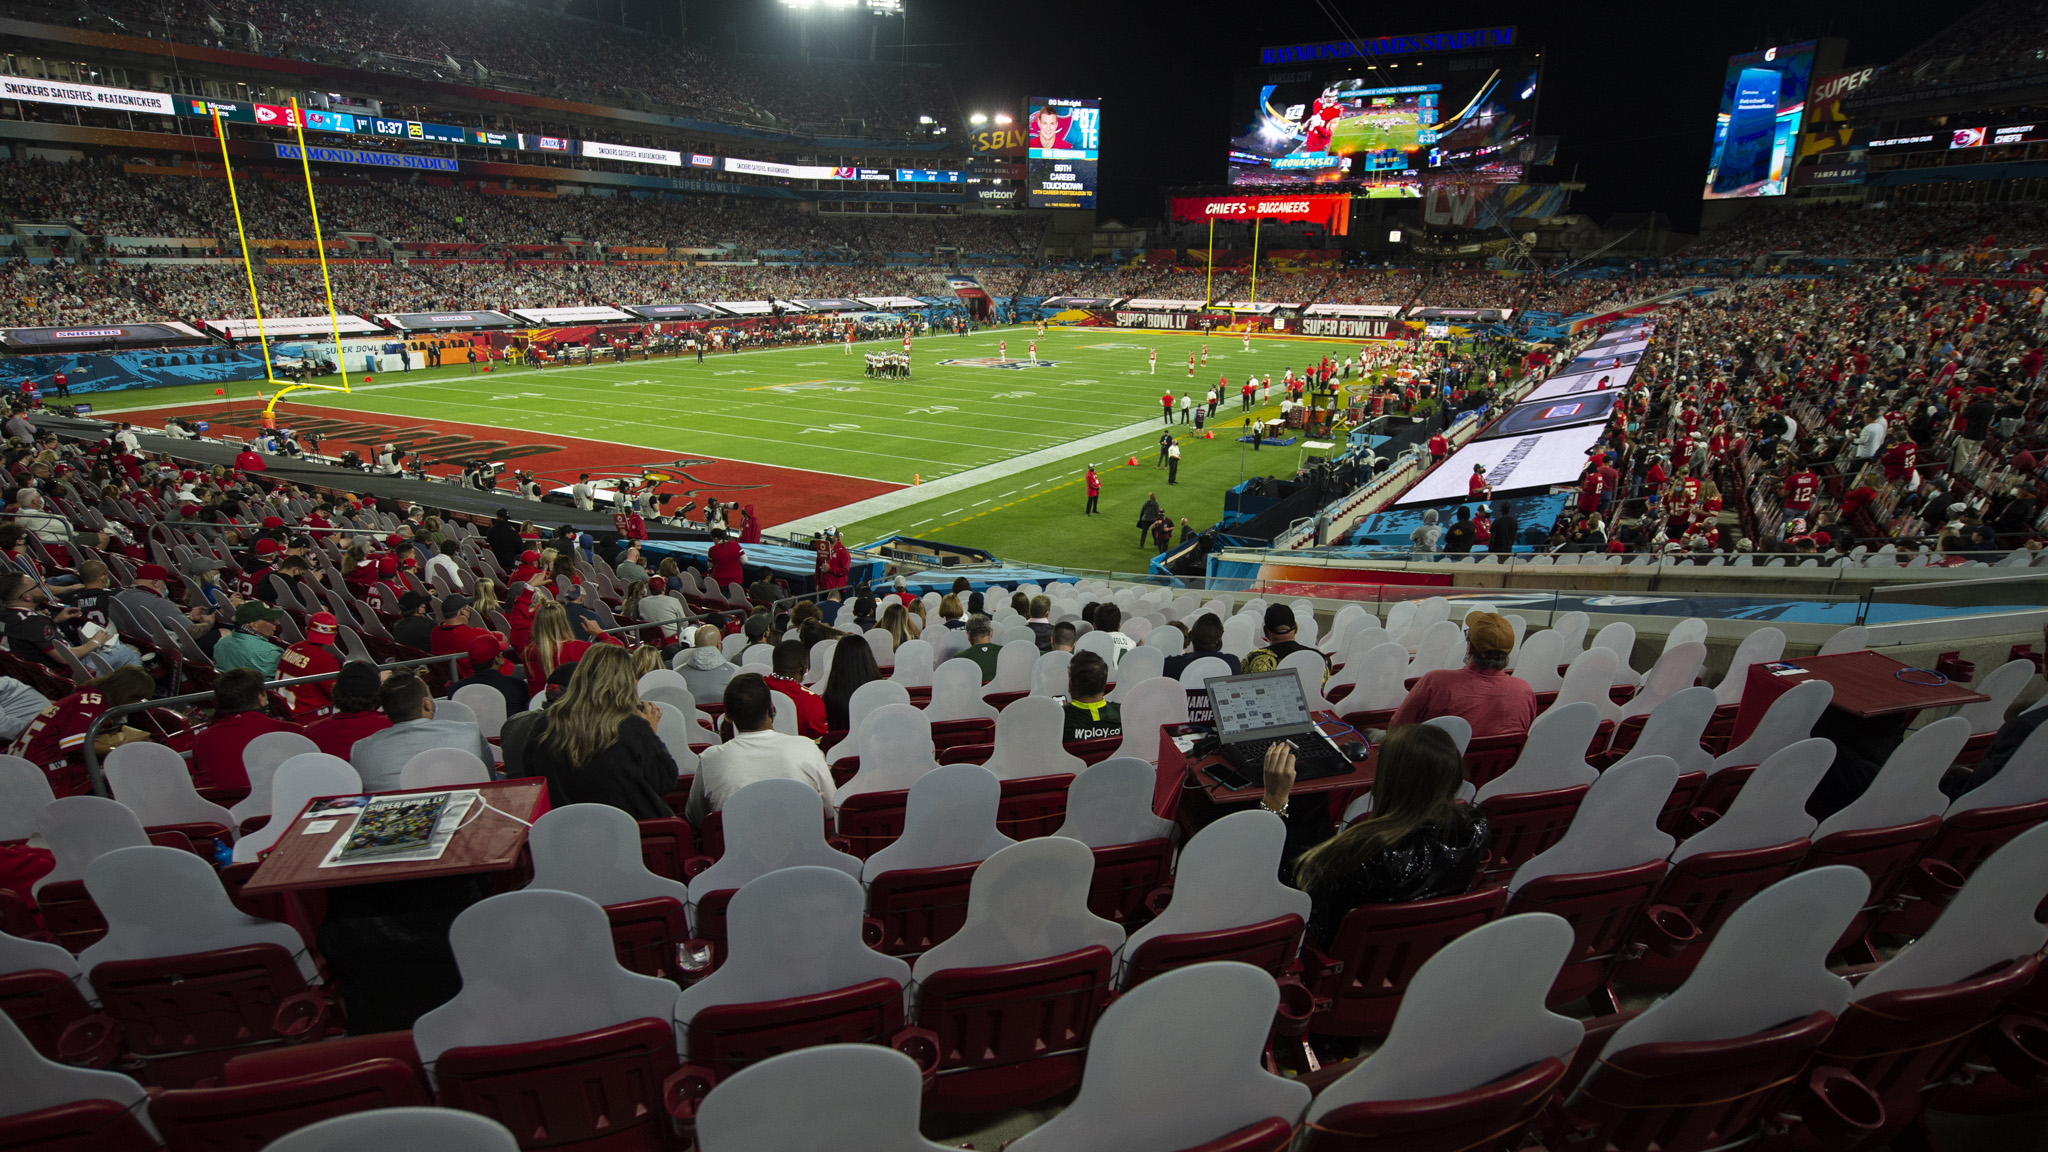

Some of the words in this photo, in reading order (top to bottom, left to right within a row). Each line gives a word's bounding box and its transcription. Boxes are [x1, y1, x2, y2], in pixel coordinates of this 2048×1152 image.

[1263, 42, 1354, 64] RAYMOND
[1356, 37, 1419, 57] JAMES
[1424, 28, 1512, 51] STADIUM
[1814, 68, 1874, 103] SUPER
[4, 83, 50, 97] SNICKERS
[51, 87, 95, 101] SATISFIES.
[97, 92, 162, 108] #EATASNICKERS
[206, 102, 237, 111] Microsoft
[285, 108, 294, 122] 3
[333, 113, 342, 126] 7
[1072, 108, 1098, 129] #87
[357, 118, 368, 130] 1ST
[376, 120, 403, 135] 0:37
[409, 125, 422, 136] 25
[1285, 125, 1296, 134] 87
[487, 132, 507, 140] Microsoft
[1081, 128, 1098, 149] TE
[355, 151, 400, 166] JAMES
[403, 156, 458, 171] STADIUM
[1275, 157, 1334, 167] GRONKOWSKI
[1050, 173, 1076, 182] CAREER
[1813, 170, 1838, 179] TAMPA
[1841, 169, 1857, 177] BAY
[673, 179, 700, 190] SUPER
[705, 183, 728, 193] BOWL
[731, 184, 741, 194] LV
[1042, 182, 1083, 190] TOUCHDOWN
[978, 188, 1013, 199] verizon
[1205, 202, 1246, 214] CHIEFS
[1257, 201, 1310, 213] BUCCANEERS
[1147, 313, 1175, 328] BOWL
[1176, 314, 1188, 329] LV
[1302, 319, 1338, 335] SUPER
[1339, 320, 1371, 336] BOWL
[1373, 321, 1389, 337] LV
[356, 345, 379, 353] BOWL
[1793, 487, 1812, 502] 12
[79, 692, 103, 705] 15
[368, 801, 402, 811] SUPER
[429, 795, 446, 804] LV
